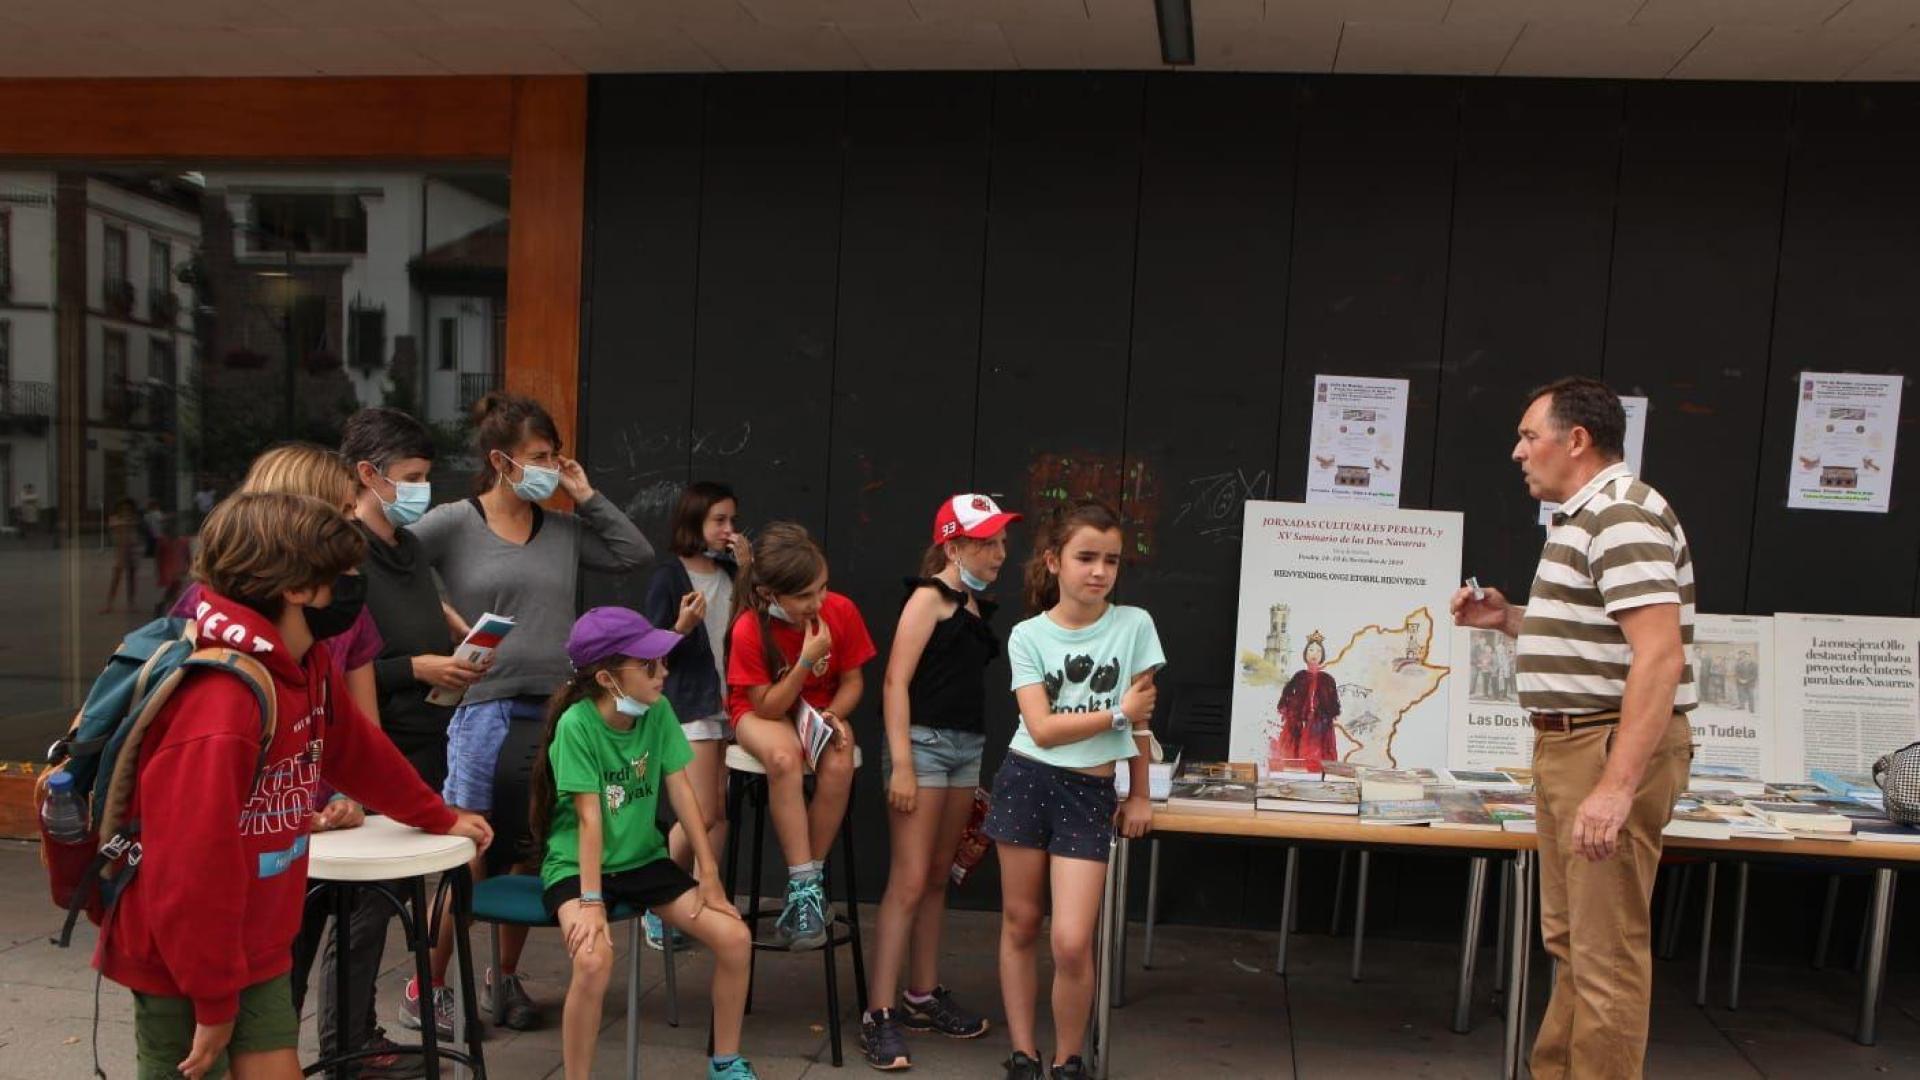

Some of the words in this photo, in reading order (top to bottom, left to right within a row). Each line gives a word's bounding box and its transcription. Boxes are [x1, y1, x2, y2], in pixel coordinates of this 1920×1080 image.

[1263, 517, 1317, 528] JORNADAS
[1319, 520, 1385, 533] CULTURALES
[1387, 524, 1436, 536] PERALTA,
[1277, 531, 1291, 540] XV
[1294, 532, 1338, 543] Seminario
[1340, 535, 1350, 544] de
[1352, 536, 1364, 545] las
[1367, 537, 1384, 545] Dos
[1386, 538, 1426, 548] Navarras
[1812, 636, 1826, 648] La
[1826, 638, 1879, 652] consejera
[1881, 640, 1905, 651] Ollo
[1805, 648, 1847, 661] destaca
[1847, 650, 1857, 661] el
[1858, 652, 1903, 665] impulso
[1805, 663, 1858, 675] proyectos
[1859, 664, 1874, 674] de
[1803, 676, 1828, 687] para
[1829, 674, 1844, 685] las
[1845, 675, 1865, 686] dos
[1866, 676, 1915, 689] Navarras
[1468, 712, 1492, 726] Las
[1494, 713, 1519, 727] Dos
[1708, 724, 1757, 739] Tudela
